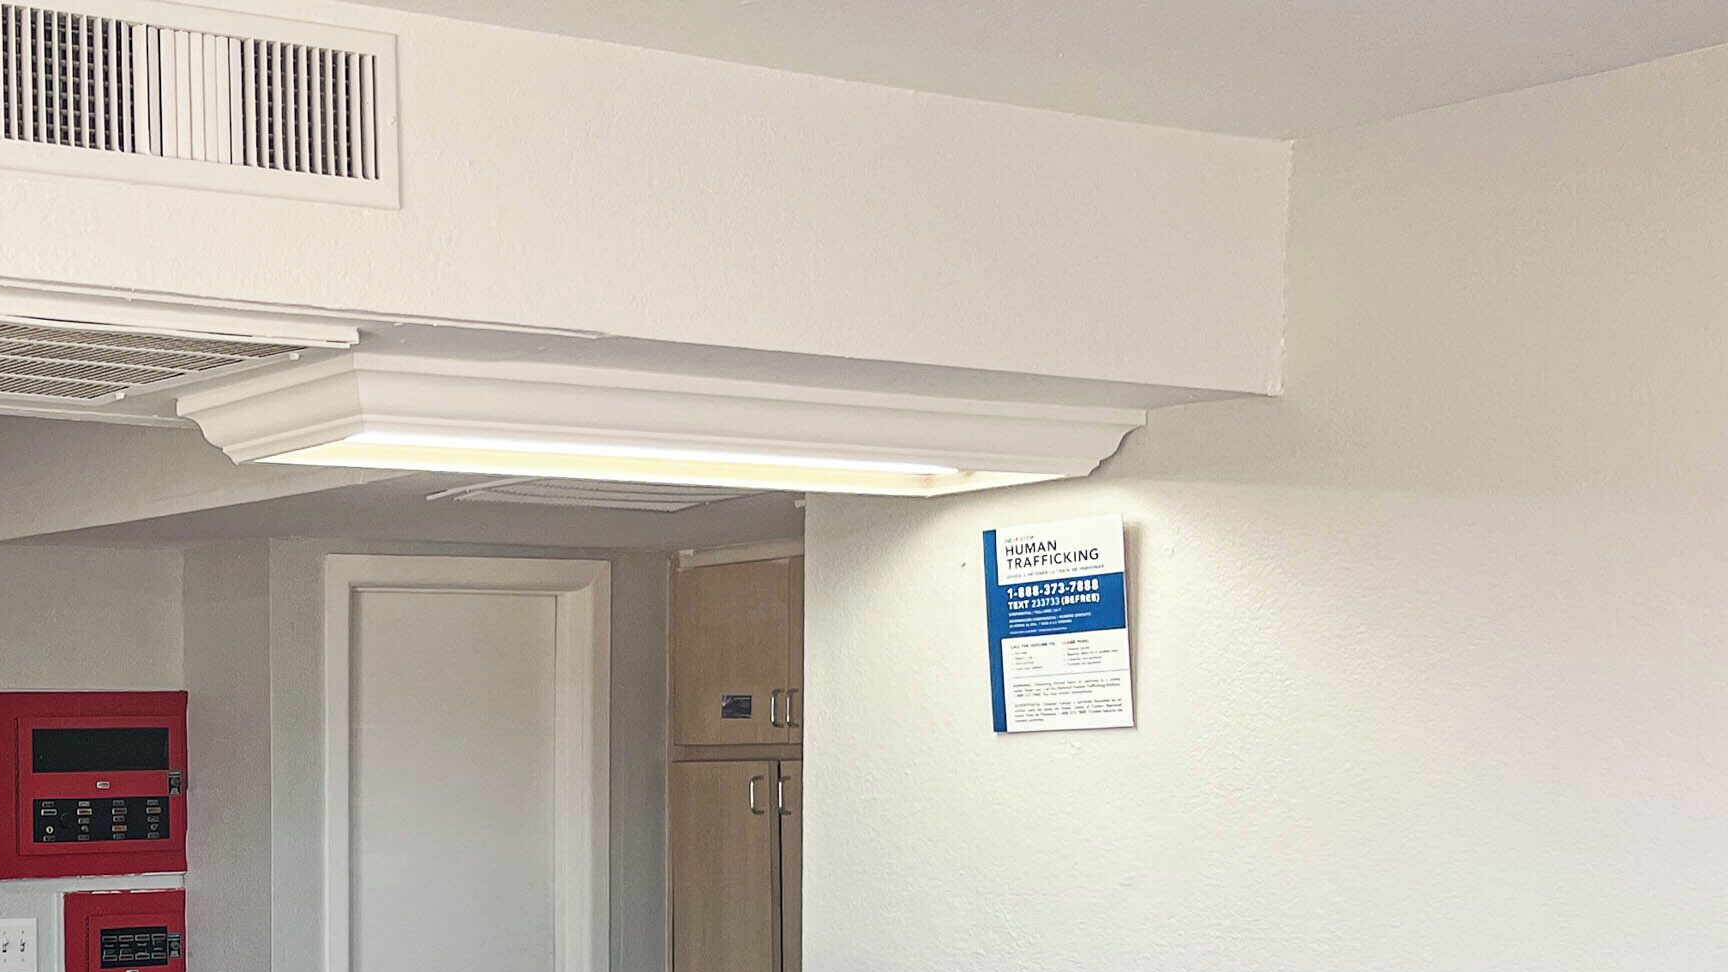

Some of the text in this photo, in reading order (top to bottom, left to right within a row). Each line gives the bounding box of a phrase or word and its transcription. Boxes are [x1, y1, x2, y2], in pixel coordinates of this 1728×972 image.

[1005, 540, 1057, 556] HUMAN
[1007, 548, 1099, 570] TRAFFICKING
[1007, 578, 1099, 599] 1-888-373-7888
[1008, 593, 1100, 610] TEXT 233733 (BEFREE)
